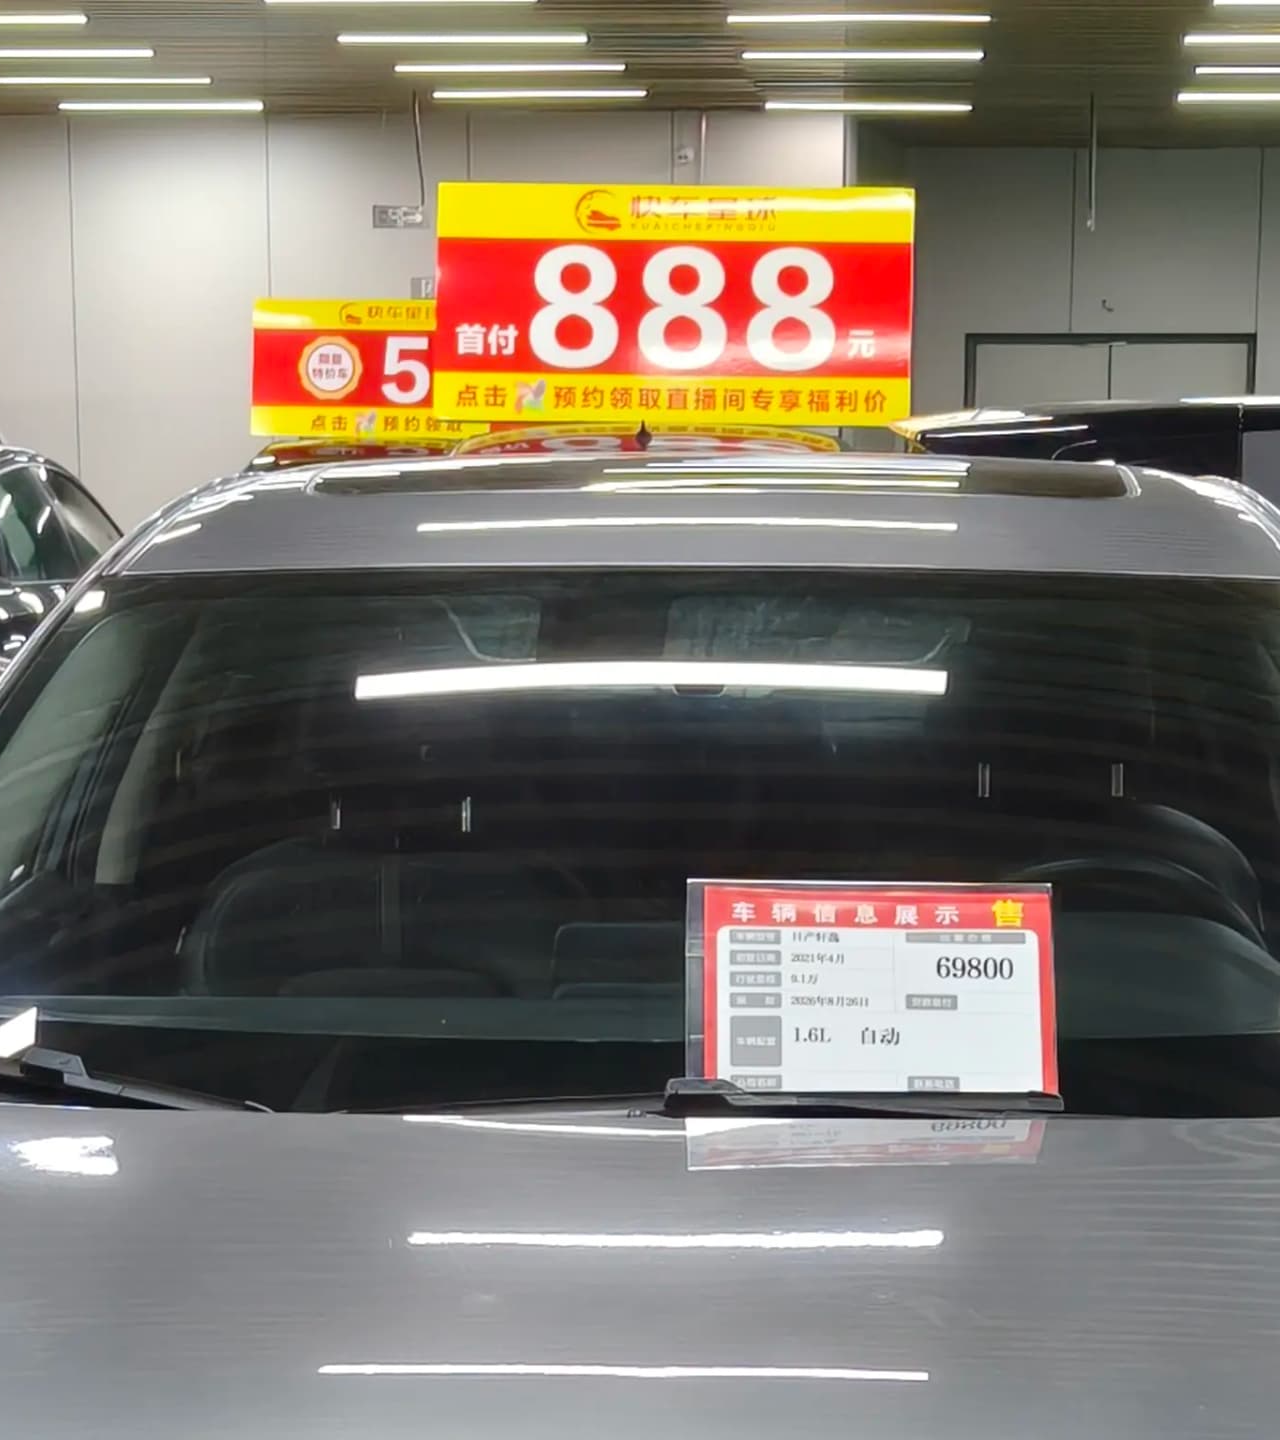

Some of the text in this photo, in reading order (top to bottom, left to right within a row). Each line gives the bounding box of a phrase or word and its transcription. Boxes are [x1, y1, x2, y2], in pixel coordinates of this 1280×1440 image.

[455, 243, 877, 371] 首付 888 元
[381, 336, 431, 404] 5
[456, 385, 888, 414] 点击 预约领取直播间专享福利价
[311, 416, 348, 432] 点击
[731, 899, 1026, 928] 车辆信息展示 售
[936, 956, 1014, 980] 69800
[794, 1026, 901, 1046] 1.6L 自动
